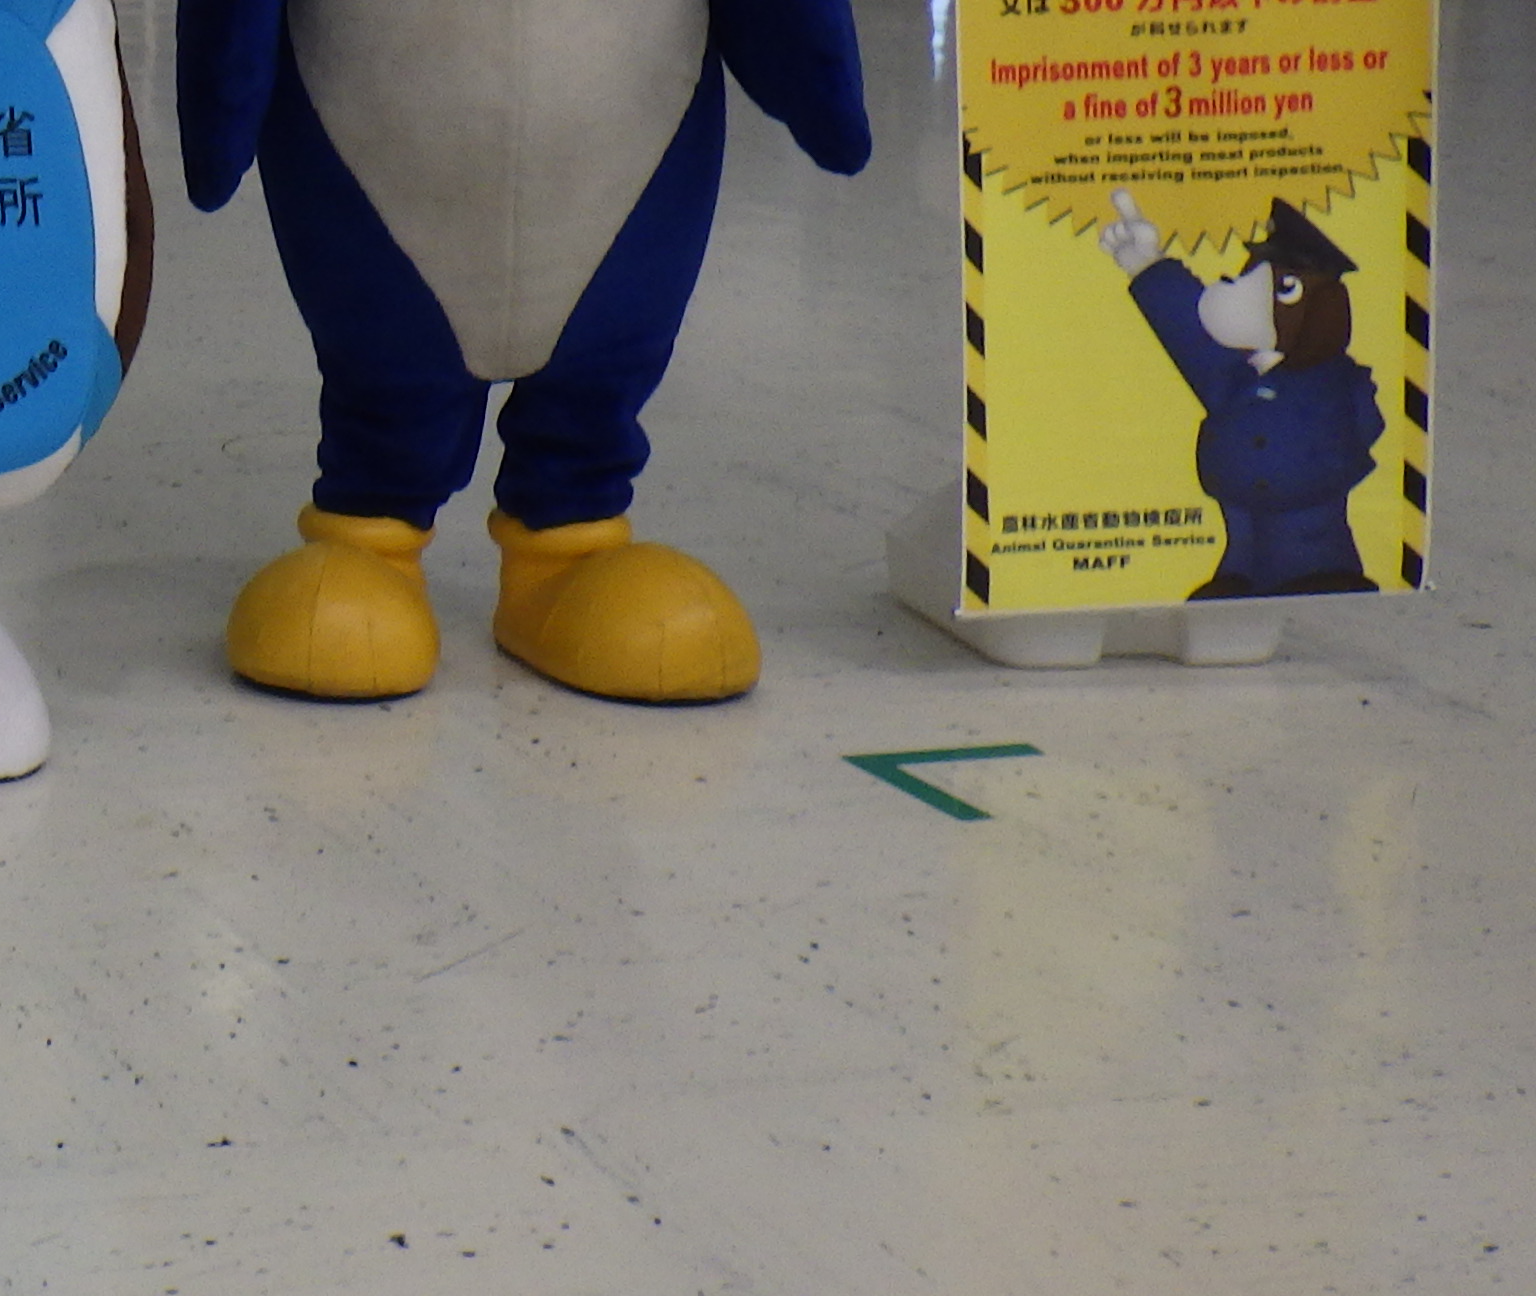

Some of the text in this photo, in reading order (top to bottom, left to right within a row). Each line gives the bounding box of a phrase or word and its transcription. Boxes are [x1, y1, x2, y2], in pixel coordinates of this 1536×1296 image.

[991, 46, 1389, 90] Imprisonment of 3 years or less or
[1064, 85, 1314, 120] a fine of 3 million yen
[1150, 130, 1182, 143] will
[1188, 131, 1210, 143] be
[1053, 153, 1100, 165] when
[1106, 151, 1193, 169] importing
[1249, 145, 1324, 160] products
[1030, 171, 1096, 184] without
[1191, 166, 1248, 181] import
[991, 533, 1217, 554] Animal Quarantine Service
[1072, 555, 1131, 571] MAFF
